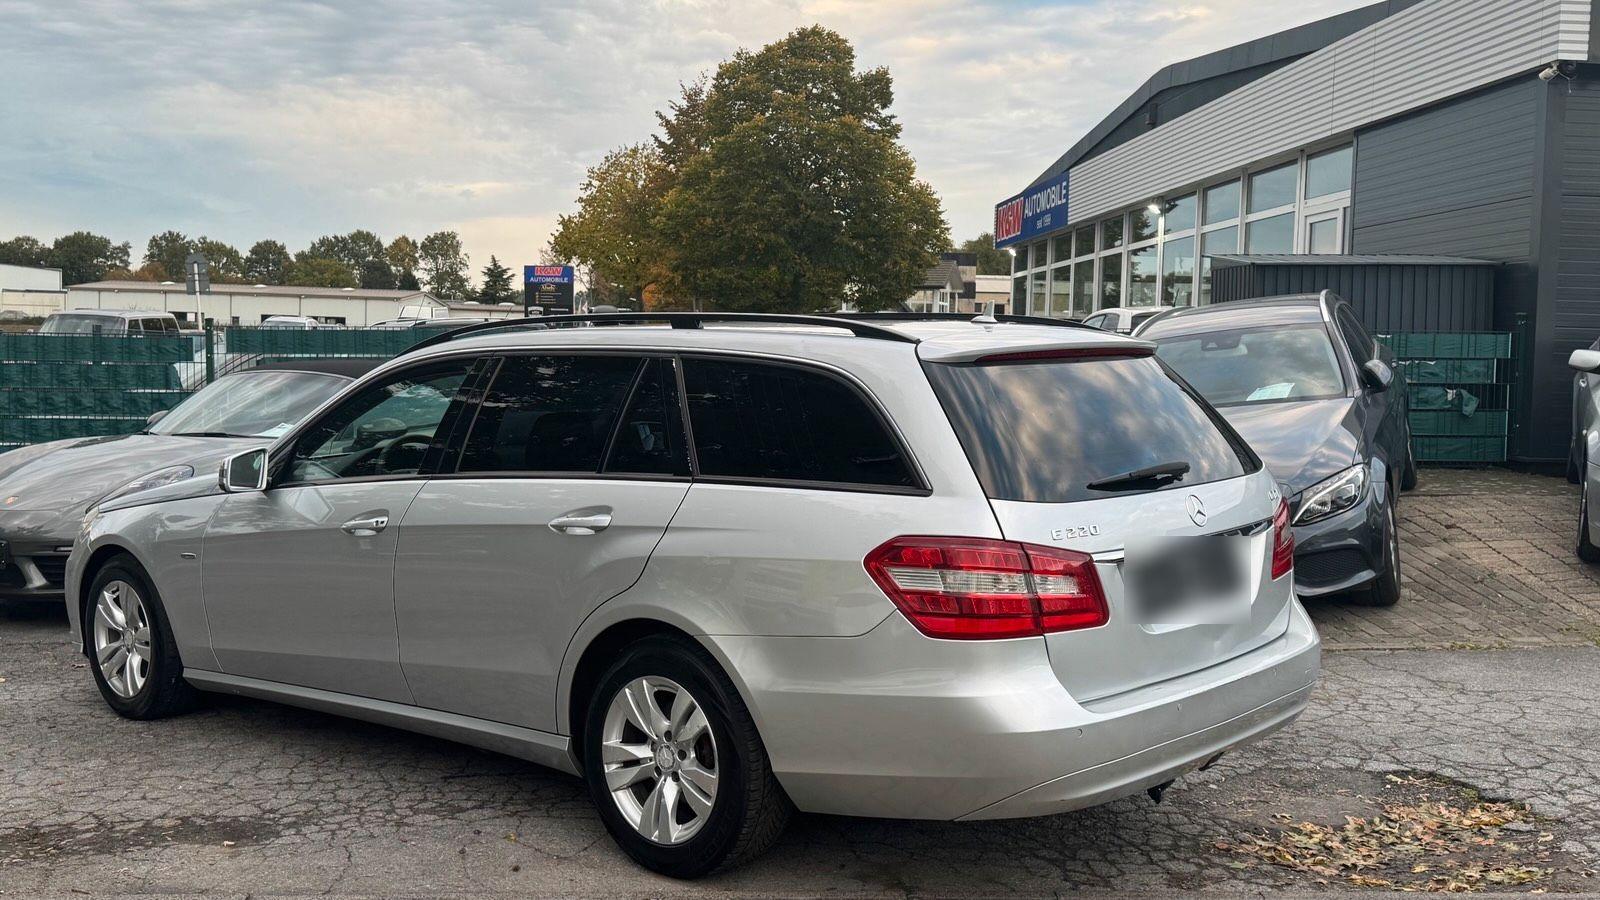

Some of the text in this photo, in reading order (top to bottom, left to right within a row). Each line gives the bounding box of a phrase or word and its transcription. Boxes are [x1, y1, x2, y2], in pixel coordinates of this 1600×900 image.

[997, 181, 1066, 241] K&W AUTOMOBILE
[535, 266, 563, 276] K&W
[1051, 524, 1101, 541] E 220
